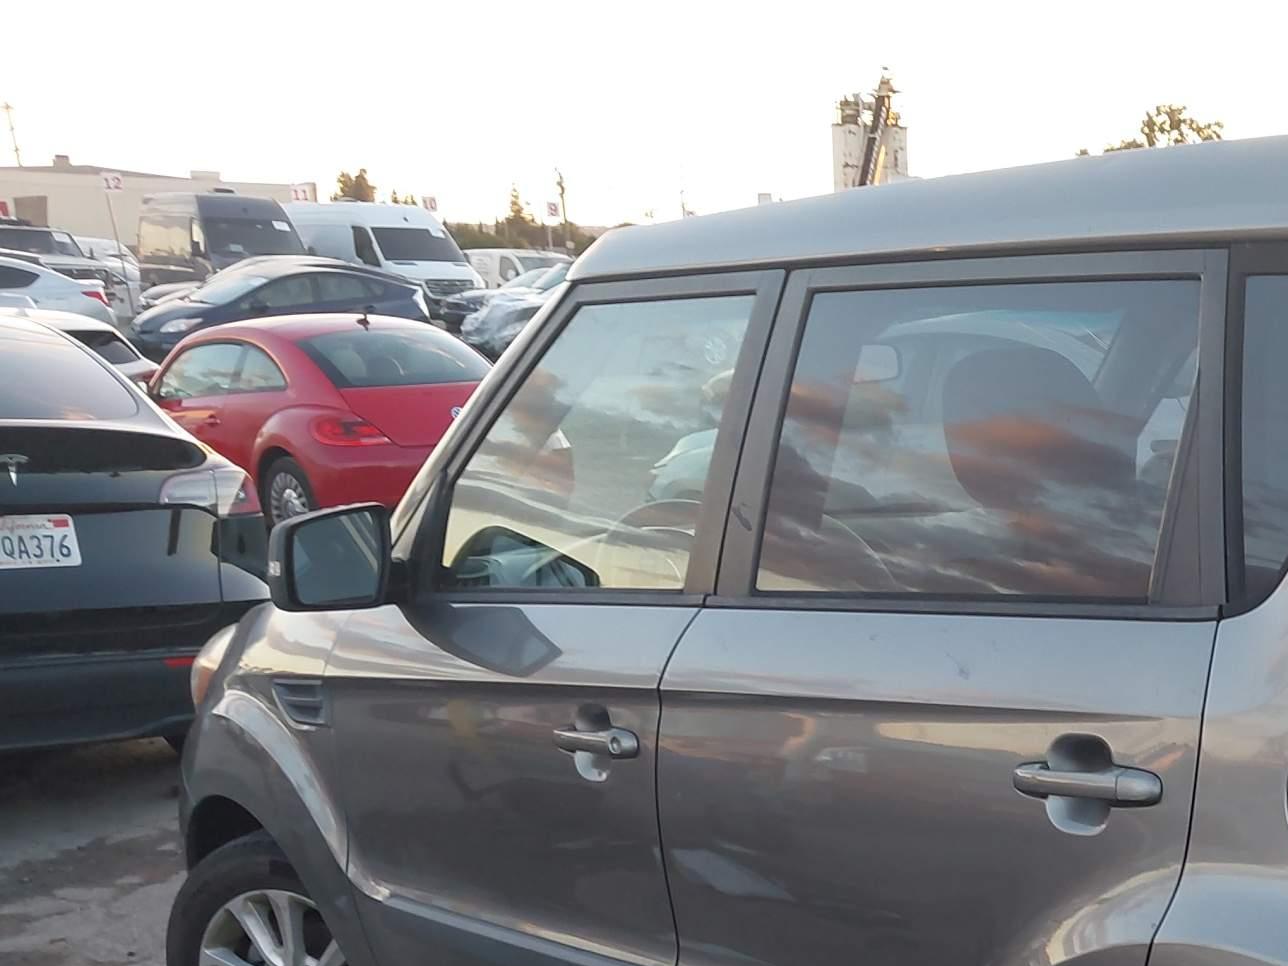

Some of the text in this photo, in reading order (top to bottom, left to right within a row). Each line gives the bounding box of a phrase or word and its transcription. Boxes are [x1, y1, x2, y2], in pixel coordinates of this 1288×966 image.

[103, 176, 123, 190] 12
[293, 188, 310, 201] 11
[423, 196, 438, 211] 10
[1, 534, 72, 560] QA376
